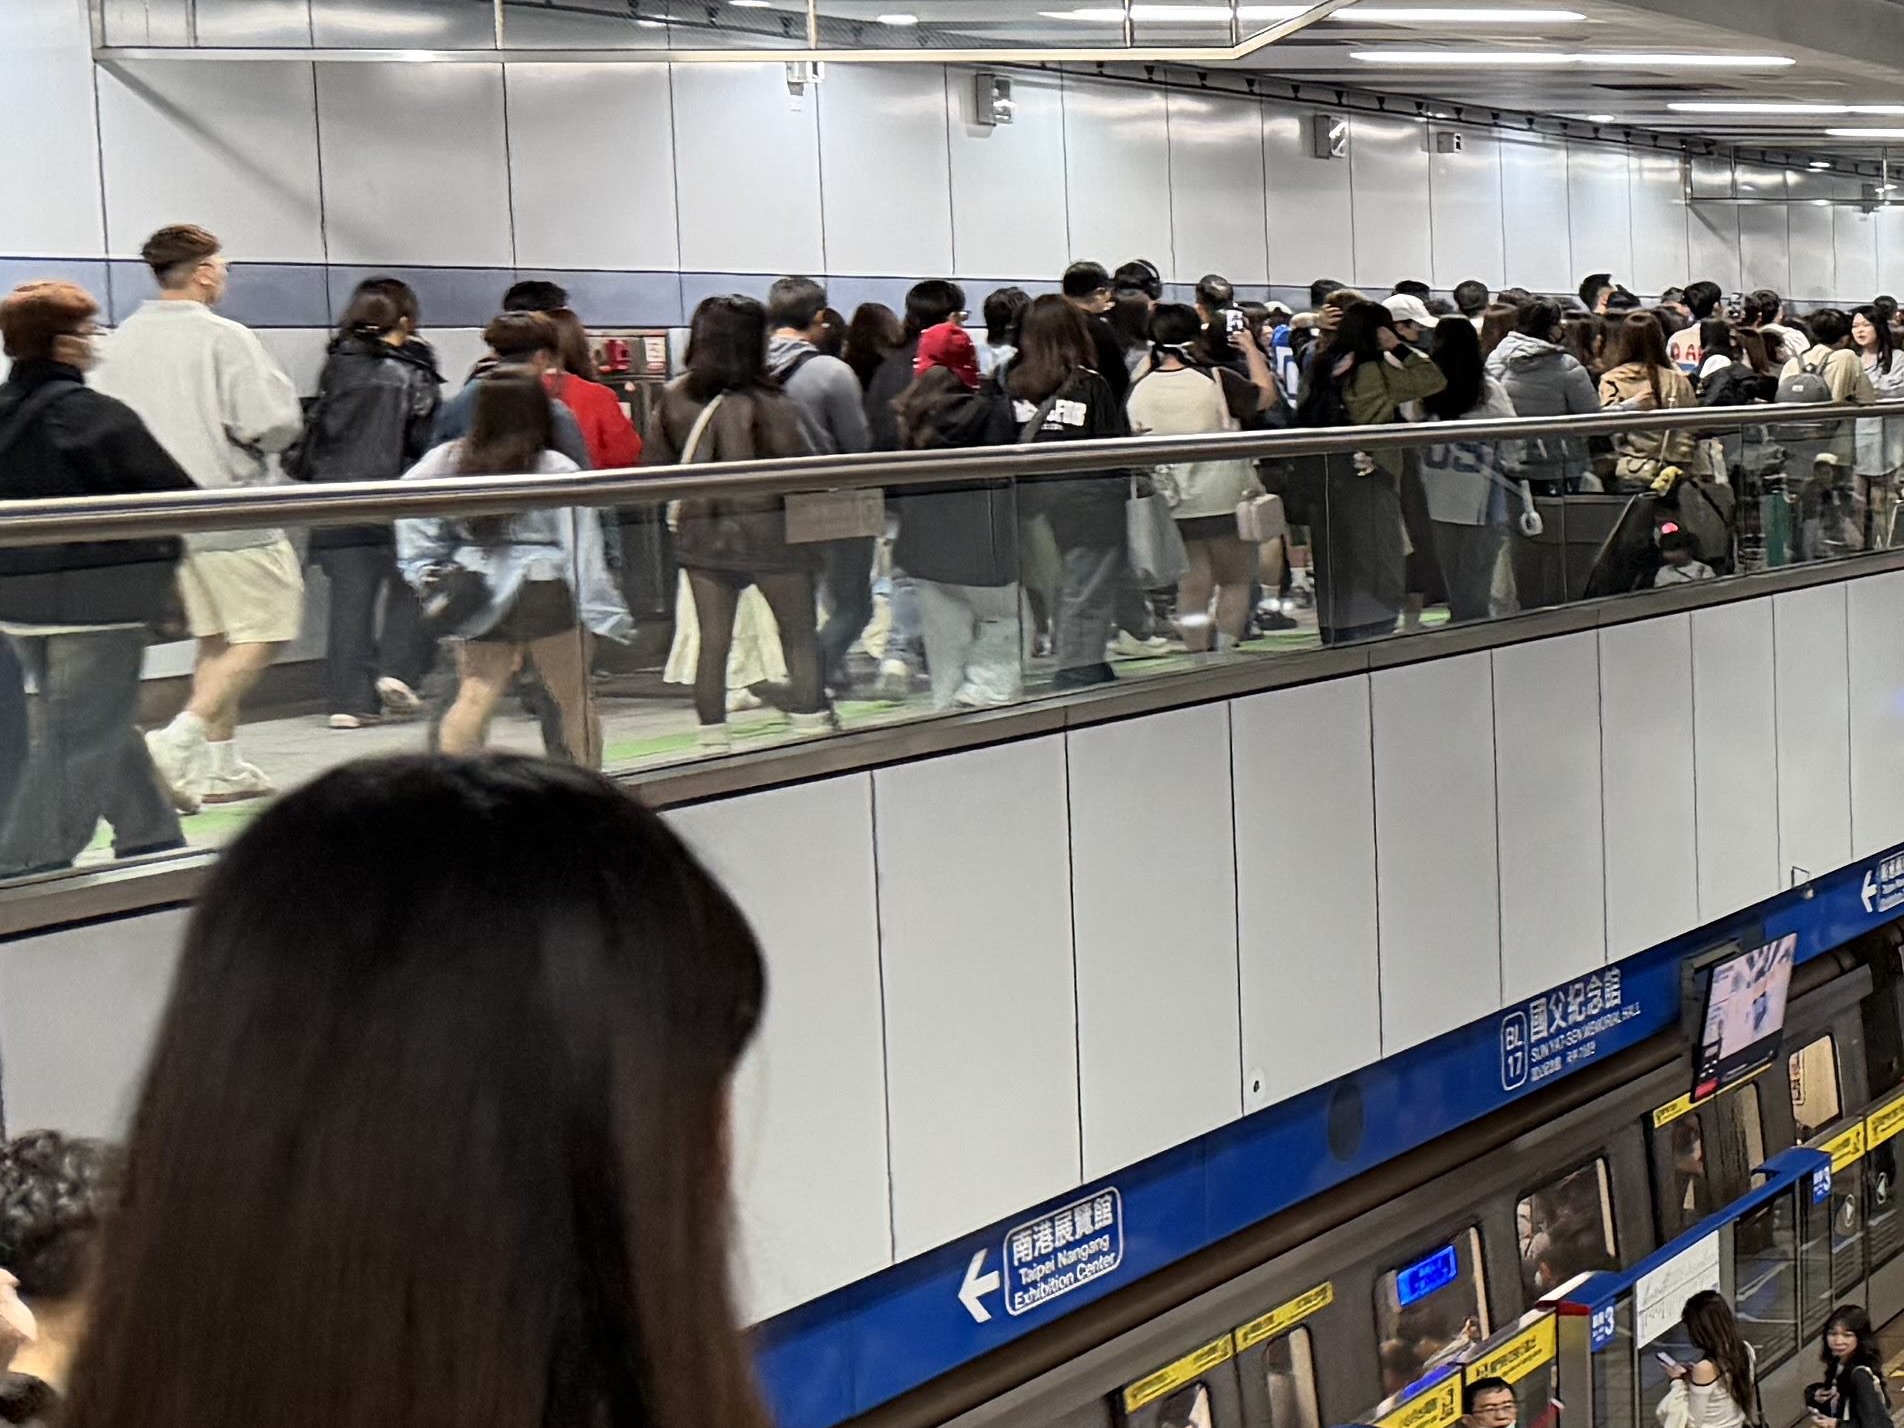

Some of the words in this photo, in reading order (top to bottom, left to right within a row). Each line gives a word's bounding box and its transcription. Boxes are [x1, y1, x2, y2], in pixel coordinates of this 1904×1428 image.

[1505, 1024, 1523, 1051] BL
[1507, 1051, 1523, 1078] 17
[1019, 1255, 1056, 1285] Taipei
[1057, 1234, 1110, 1268] Nangang
[1014, 1271, 1075, 1310] Exhibition
[1076, 1252, 1116, 1280] Center
[1603, 1306, 1615, 1335] 3
